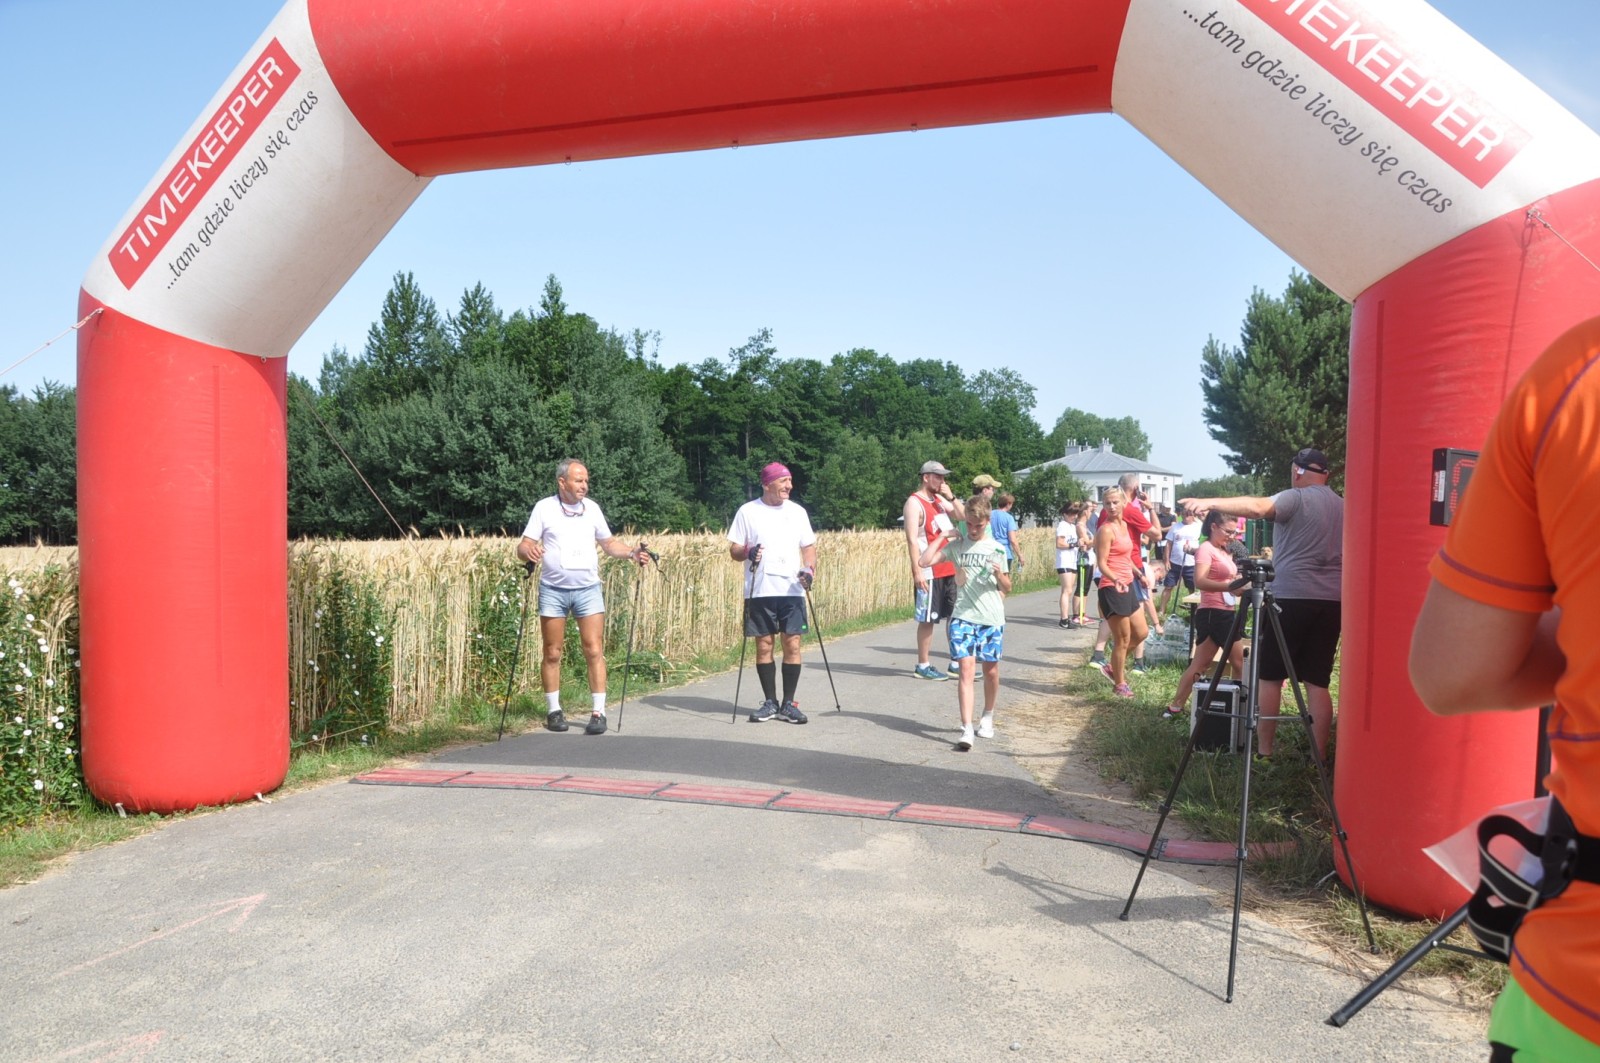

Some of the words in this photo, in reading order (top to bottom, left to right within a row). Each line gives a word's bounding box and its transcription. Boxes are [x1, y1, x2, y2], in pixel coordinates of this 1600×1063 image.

[119, 56, 284, 262] TIMEKEEPER
[197, 197, 235, 246] gdzie
[230, 155, 269, 200] liczy
[264, 129, 291, 158] się
[286, 90, 319, 131] czas
[1241, 49, 1307, 101] gdzie
[1304, 92, 1364, 146] liczy
[1360, 140, 1400, 175] się
[1397, 168, 1453, 214] czas
